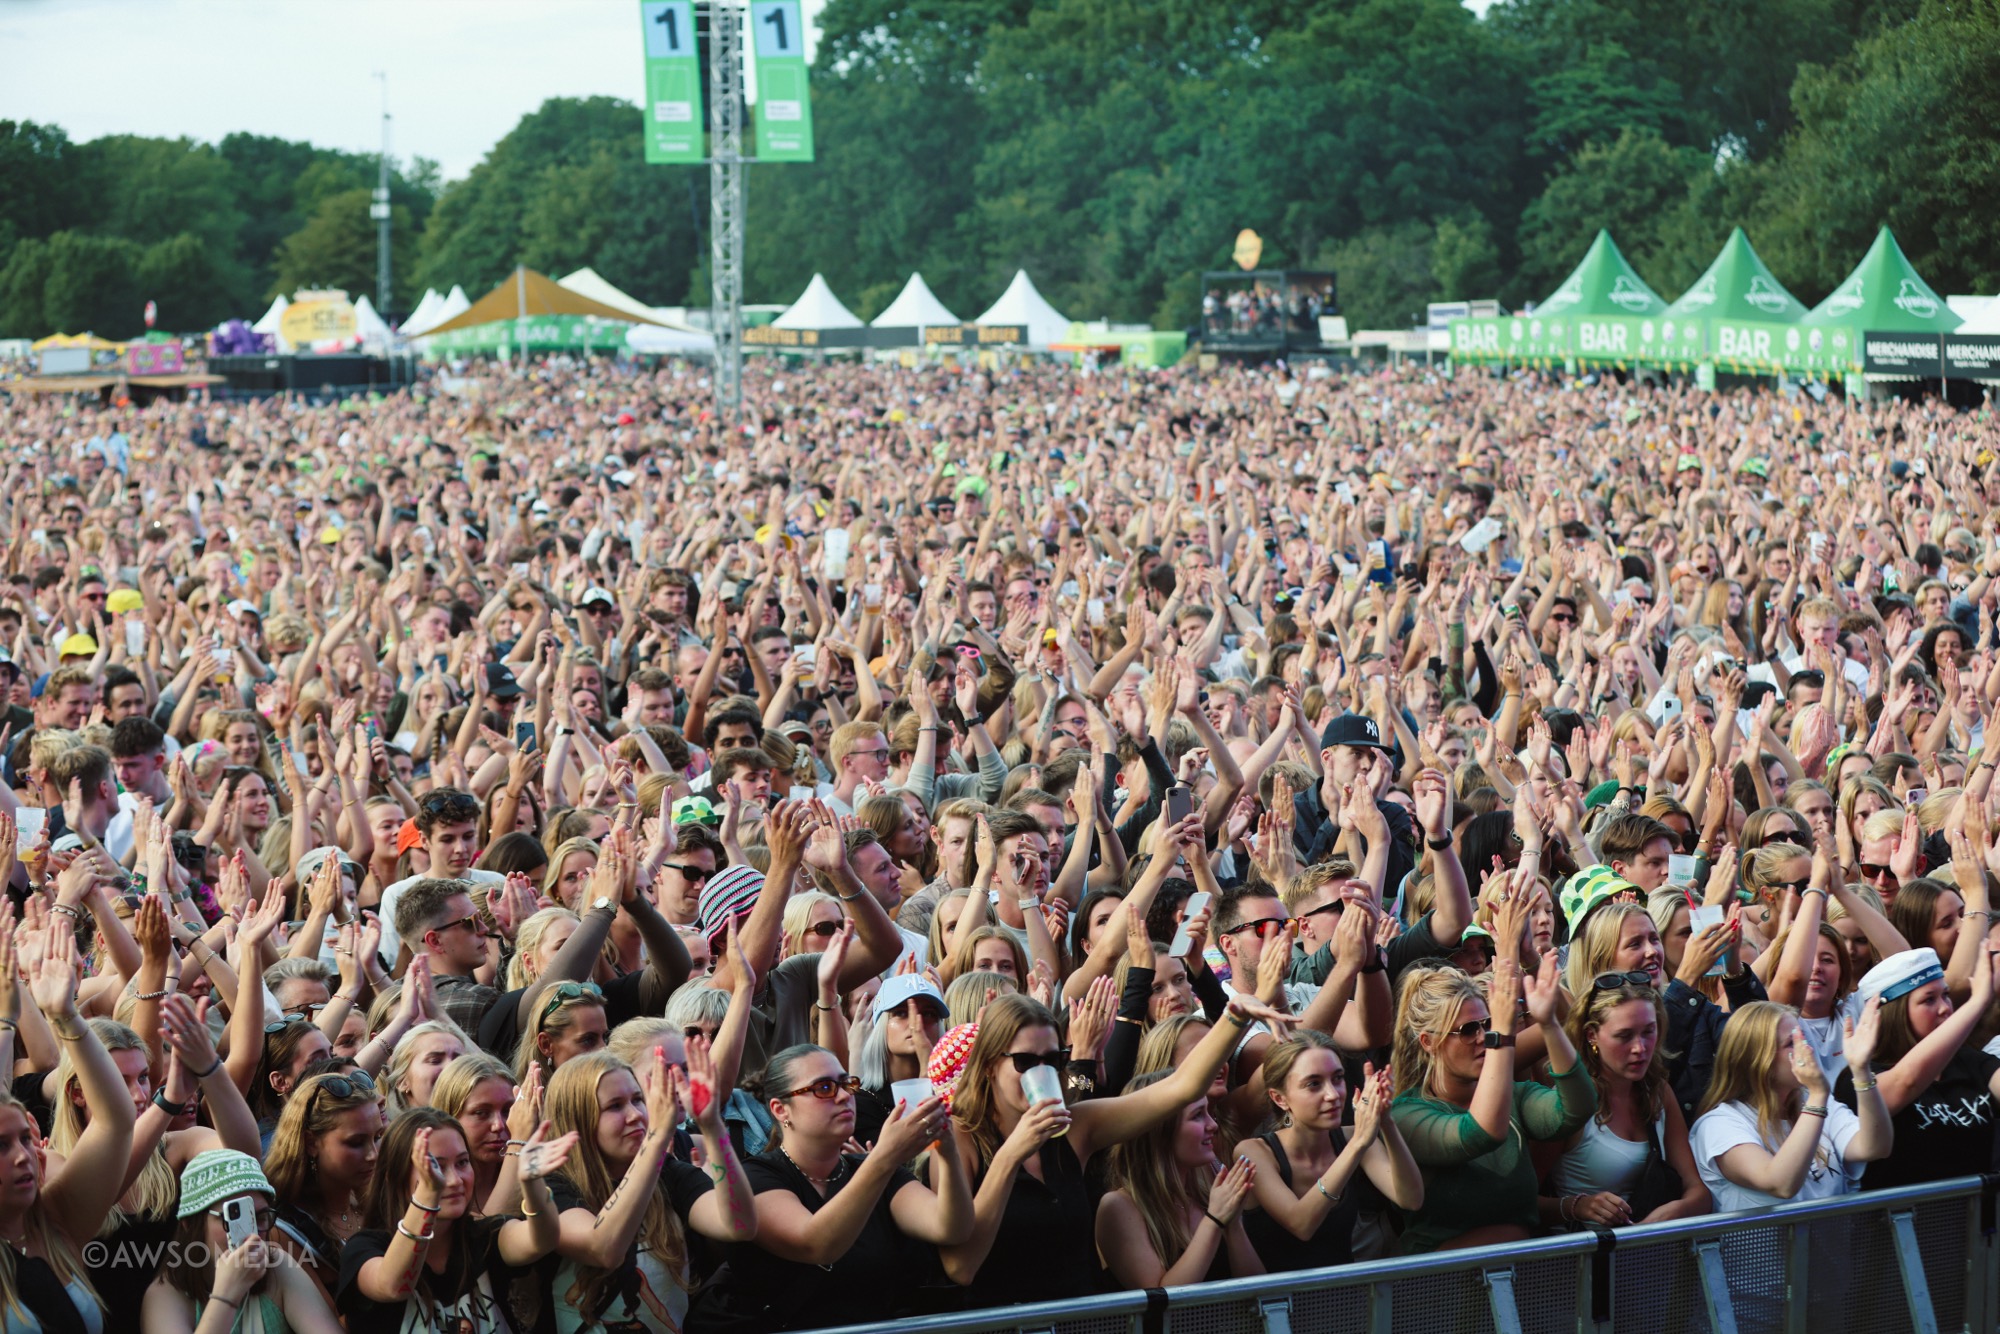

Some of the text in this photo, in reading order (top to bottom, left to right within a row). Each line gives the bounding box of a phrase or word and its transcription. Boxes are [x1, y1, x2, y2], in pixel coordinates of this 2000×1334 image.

[655, 8, 679, 50] 1
[764, 8, 788, 50] 1
[1455, 323, 1499, 351] BAR
[1579, 322, 1627, 352] BAR
[1719, 326, 1771, 358] BAR
[1866, 341, 1939, 360] MERCHANDISE
